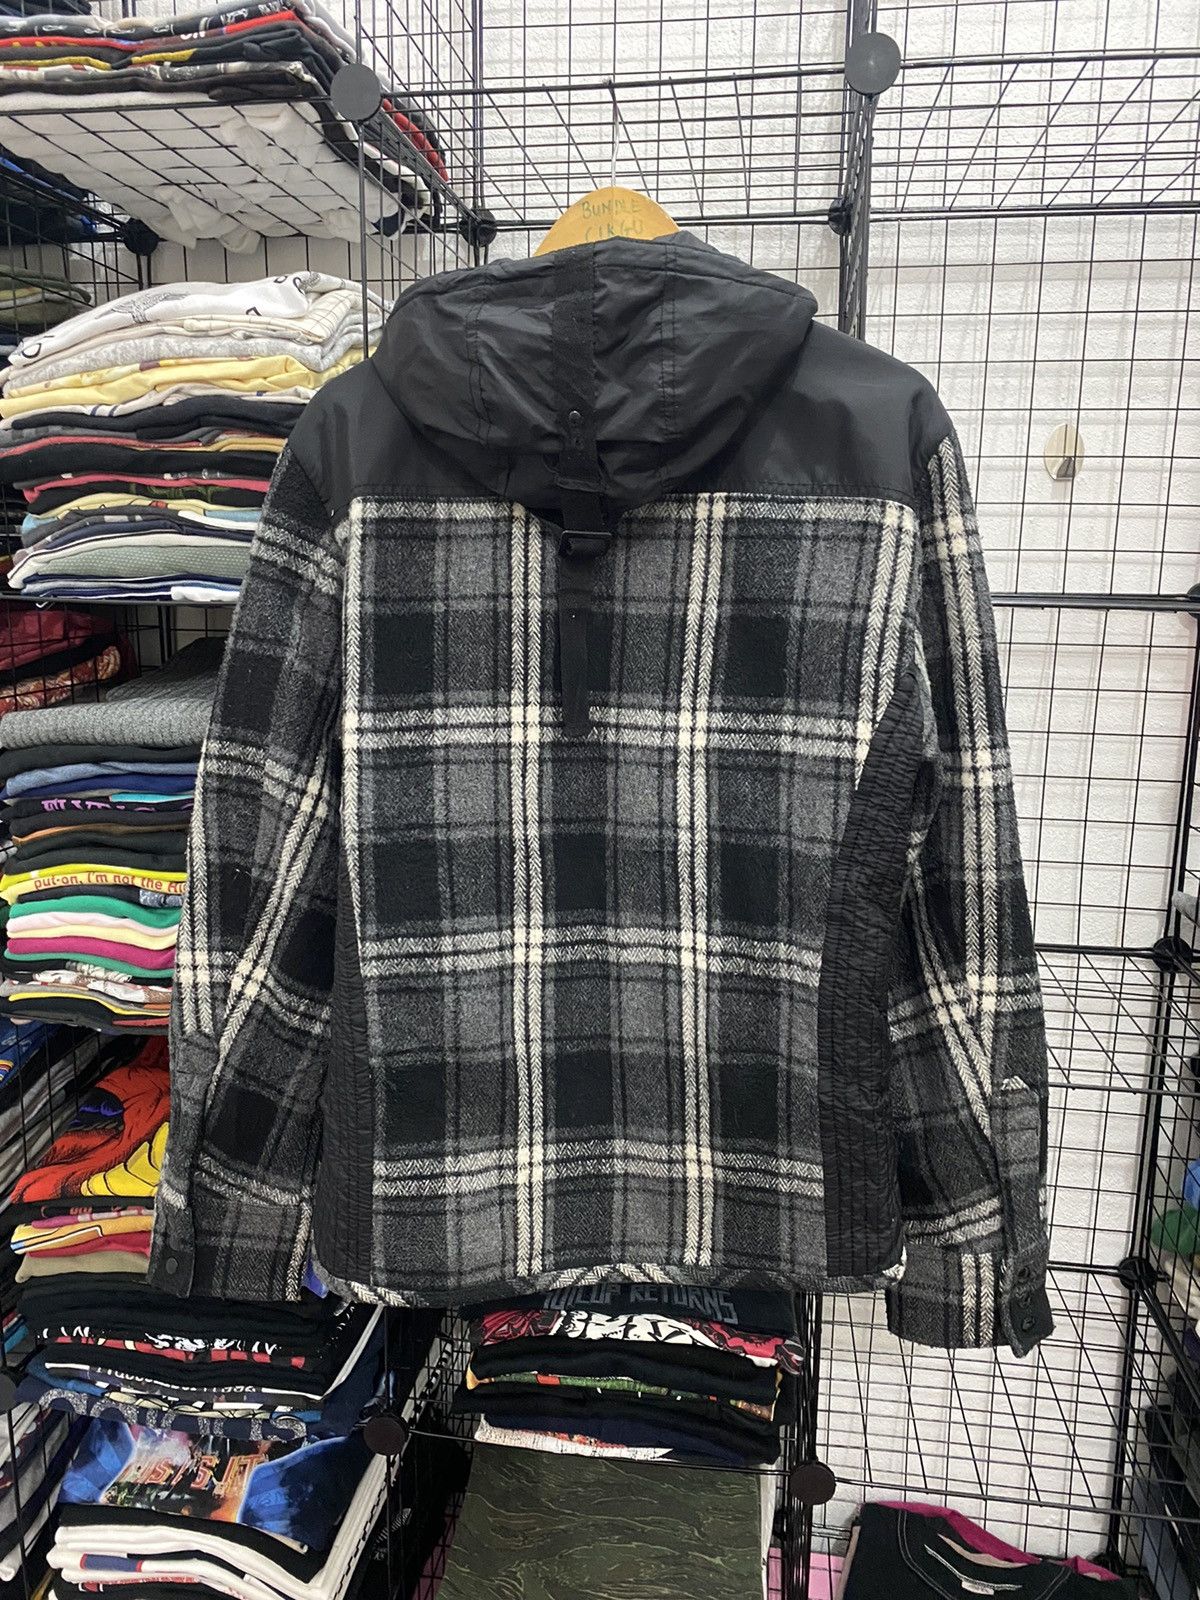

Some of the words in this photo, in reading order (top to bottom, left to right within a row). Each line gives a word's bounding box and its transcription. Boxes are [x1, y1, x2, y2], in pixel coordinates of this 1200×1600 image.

[87, 872, 109, 883] I'm
[114, 874, 137, 885] not
[141, 877, 163, 890] the
